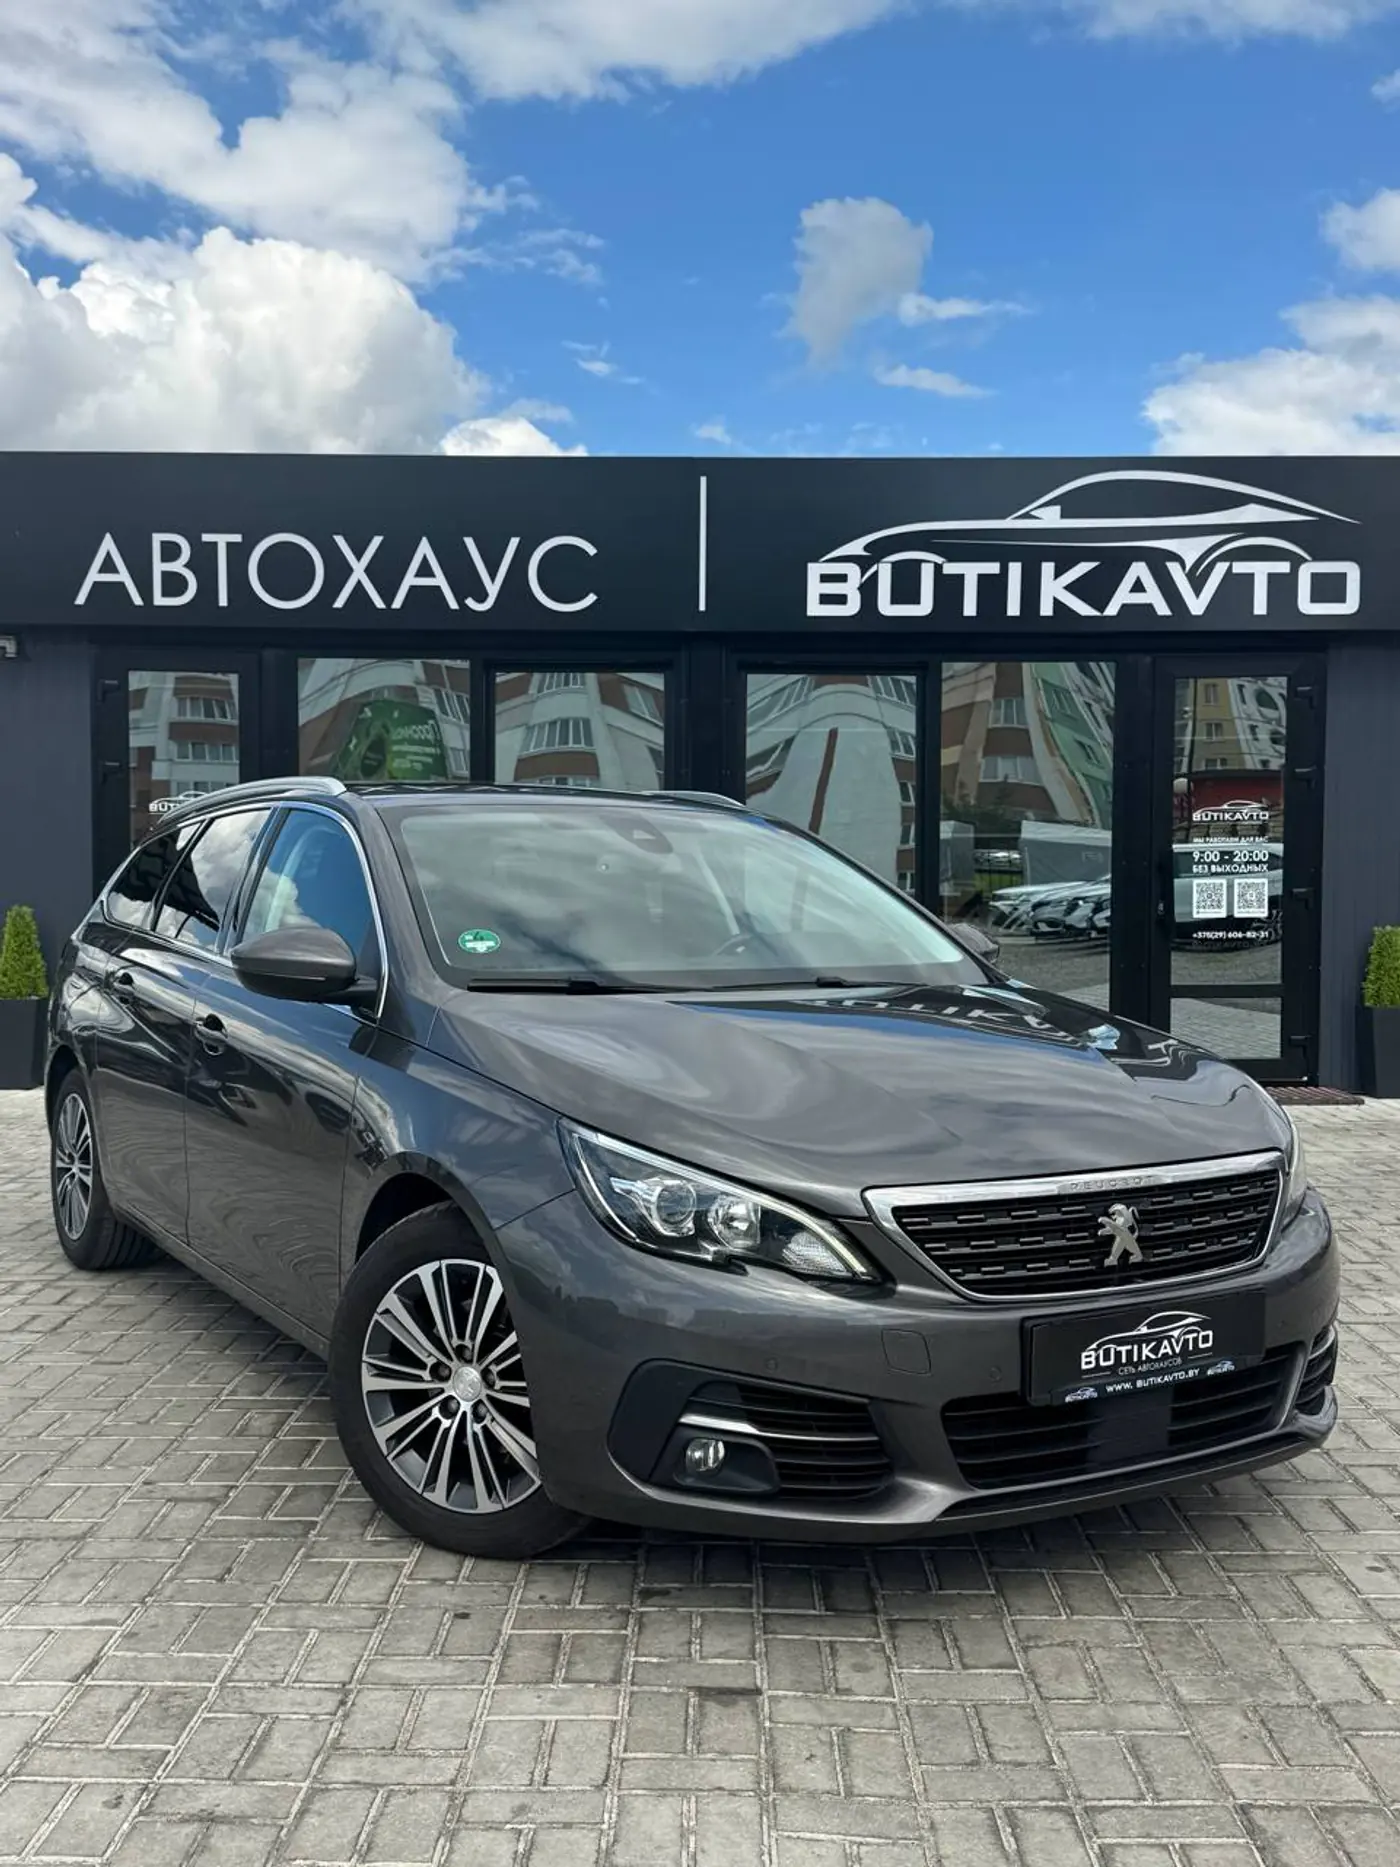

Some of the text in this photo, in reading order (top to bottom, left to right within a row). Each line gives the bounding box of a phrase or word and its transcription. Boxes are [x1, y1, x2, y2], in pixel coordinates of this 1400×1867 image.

[74, 531, 598, 614] АВТОХАУС
[806, 561, 1361, 617] BUTIKAVTO
[1192, 811, 1269, 822] BUTIKAVTO
[1192, 851, 1220, 862] 9:00
[1233, 850, 1269, 862] 20:00
[1192, 864, 1268, 873] БЕЗ ВЫХОДНЫХ
[1081, 1330, 1213, 1370] BUTIKAVTO
[1105, 1382, 1133, 1393] WWW.
[1136, 1368, 1200, 1388] BUTIKAVTO.BY
